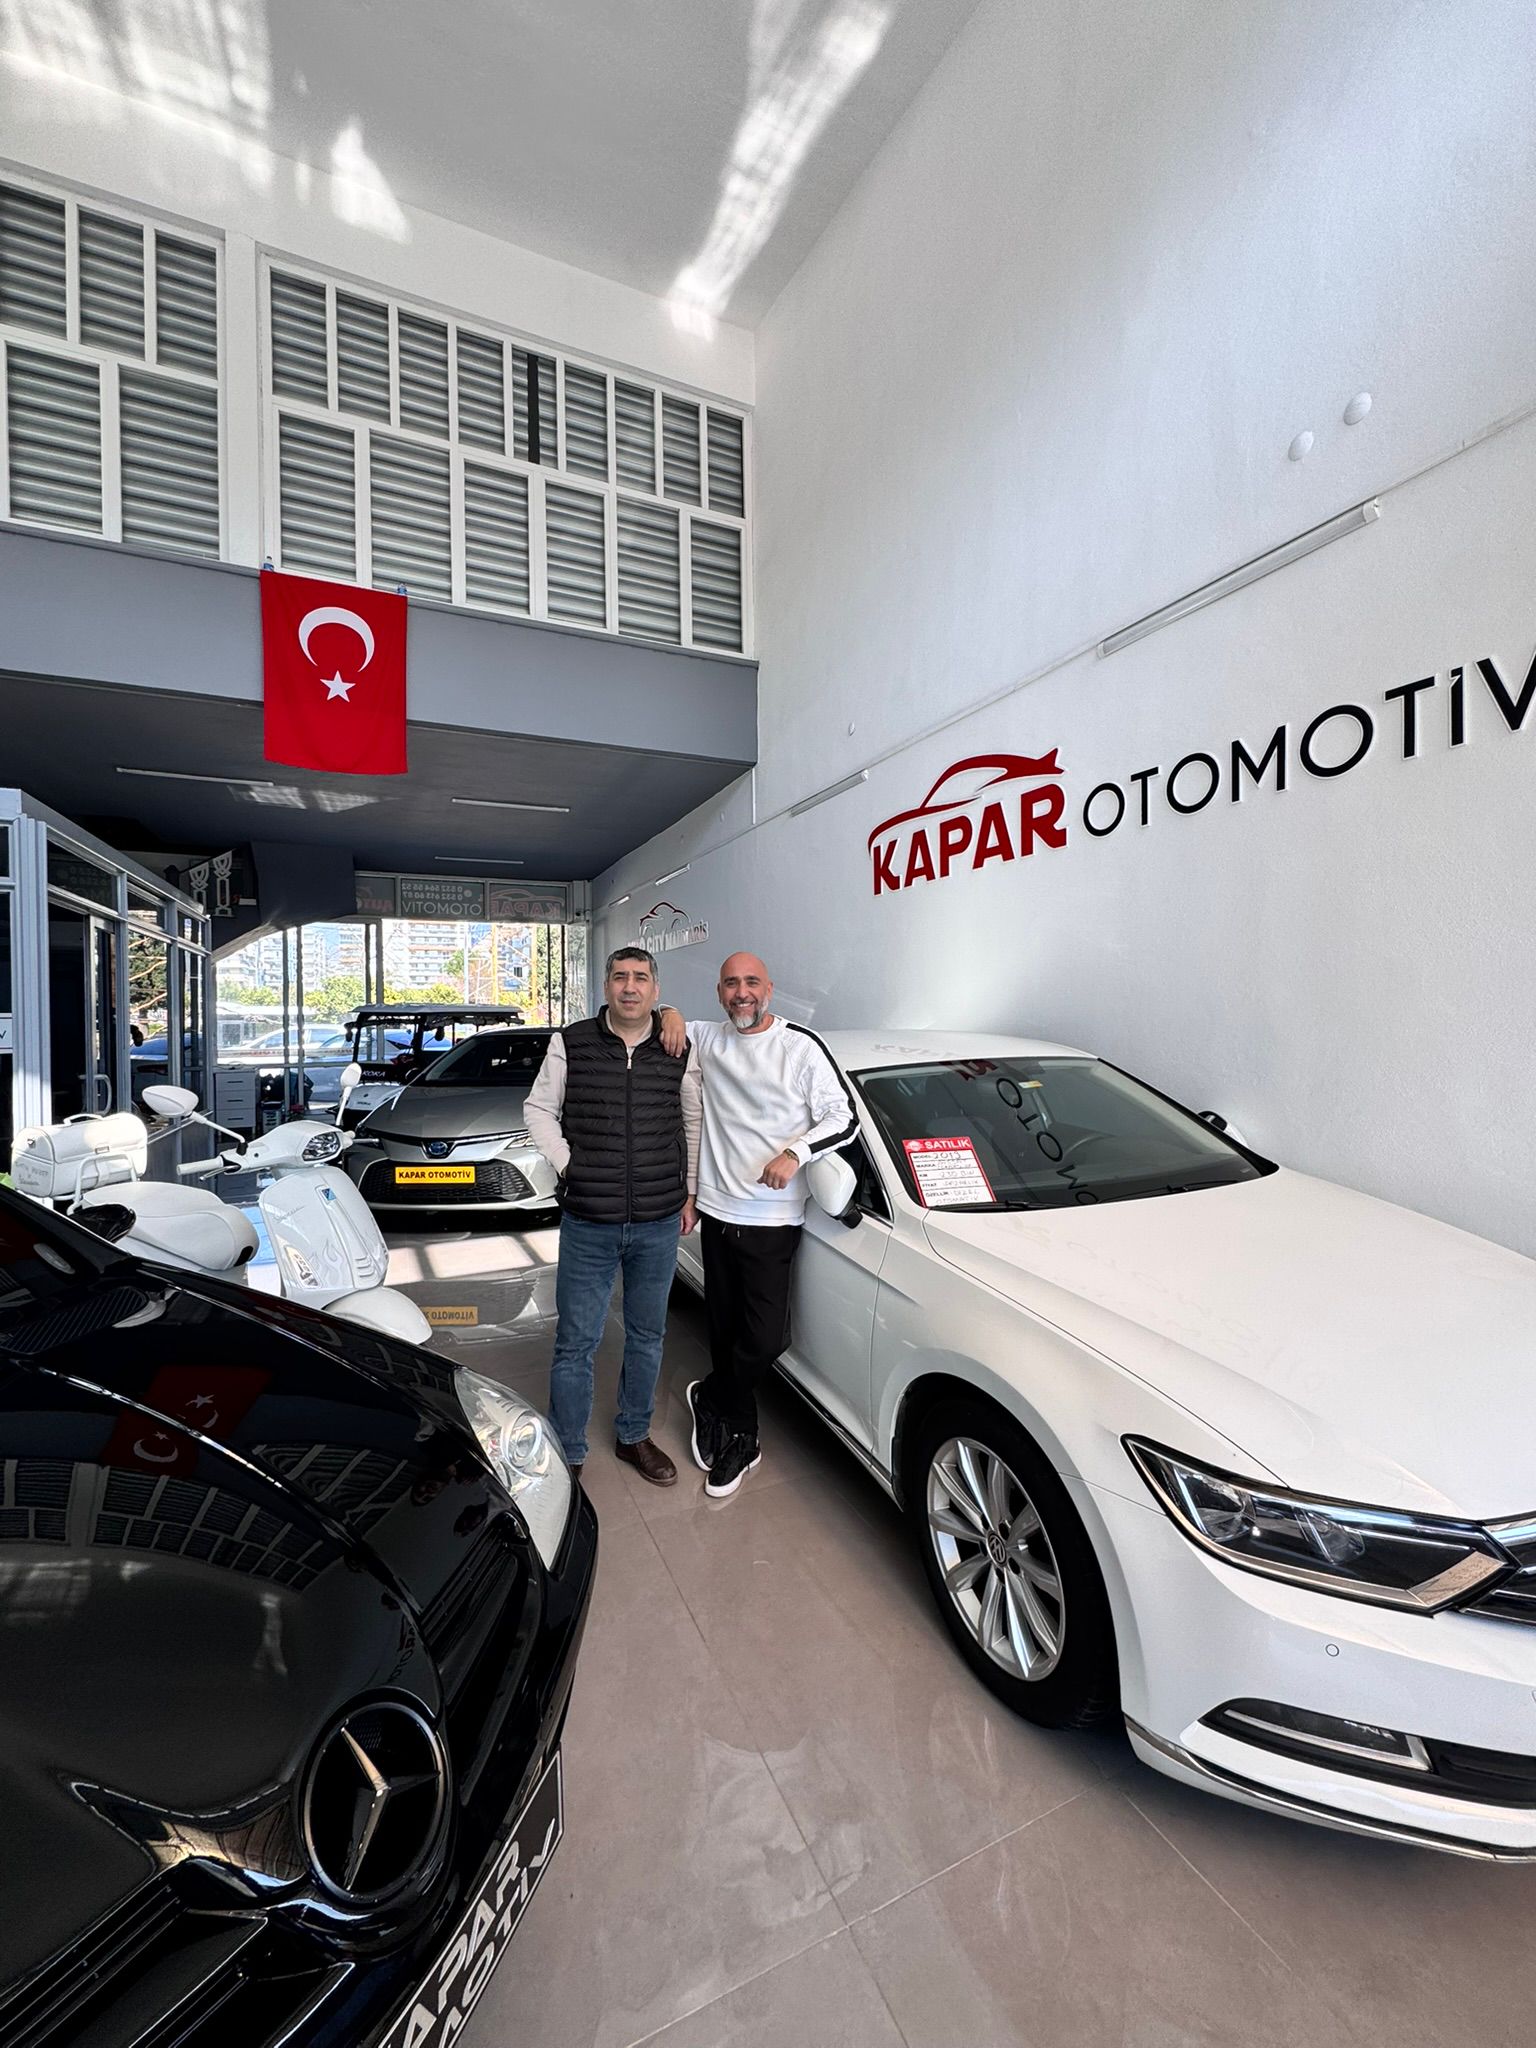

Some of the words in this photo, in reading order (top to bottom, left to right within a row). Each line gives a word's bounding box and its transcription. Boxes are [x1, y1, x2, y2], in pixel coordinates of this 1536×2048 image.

[873, 785, 1067, 895] KAPAR
[924, 1139, 971, 1149] SATILIK
[399, 1171, 426, 1179] KAPAR
[428, 1170, 471, 1179] OTOMOTİV
